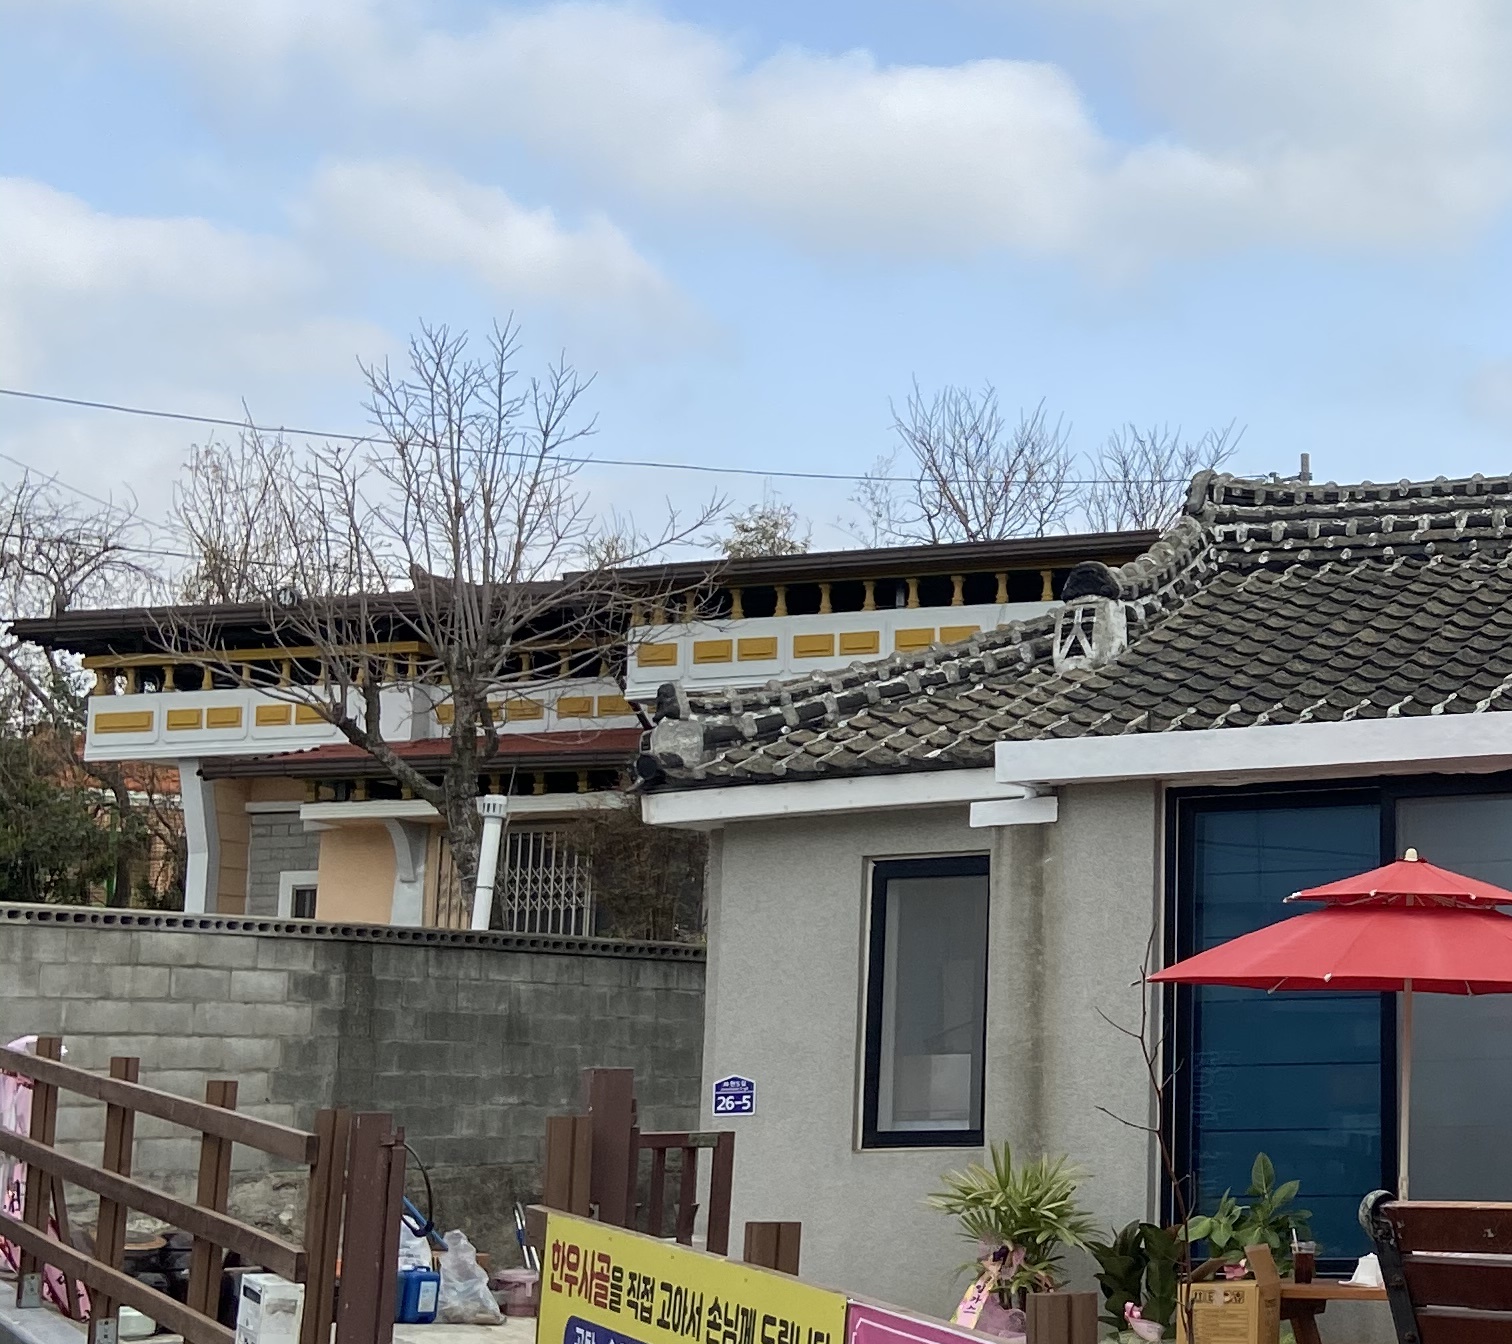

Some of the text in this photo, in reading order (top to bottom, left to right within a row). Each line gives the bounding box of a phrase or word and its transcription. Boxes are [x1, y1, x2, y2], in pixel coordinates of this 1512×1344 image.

[717, 1095, 751, 1111] 26-5
[550, 1239, 624, 1314] 한우사골을
[626, 1271, 656, 1325] 직접
[657, 1281, 705, 1342] 고아서
